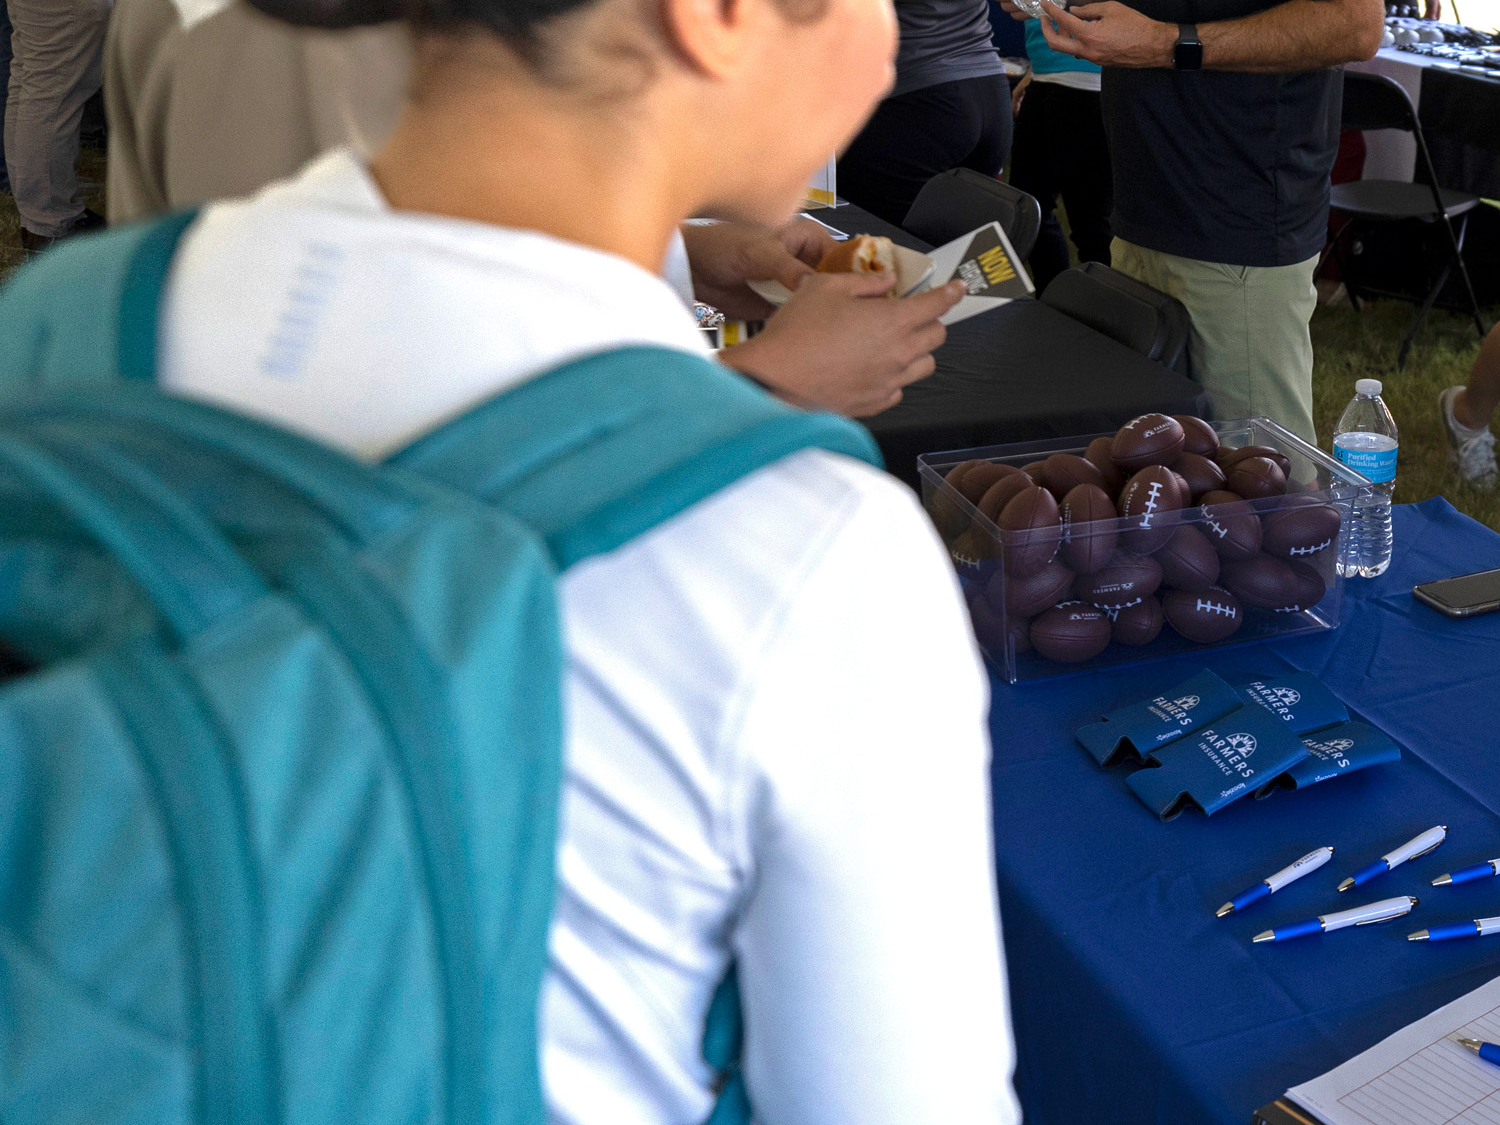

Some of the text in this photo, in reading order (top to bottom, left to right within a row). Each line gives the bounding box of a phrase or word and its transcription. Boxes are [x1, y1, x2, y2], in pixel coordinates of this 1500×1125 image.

[977, 244, 1017, 286] NOW
[1347, 453, 1376, 461] Purified
[1347, 459, 1379, 468] Drinking
[1152, 696, 1193, 726] FARMERS
[1250, 681, 1295, 722] FARMERS
[1198, 742, 1233, 777] INSURANCE
[1201, 729, 1255, 778] FARMERS
[1301, 738, 1350, 768] FARMERS
